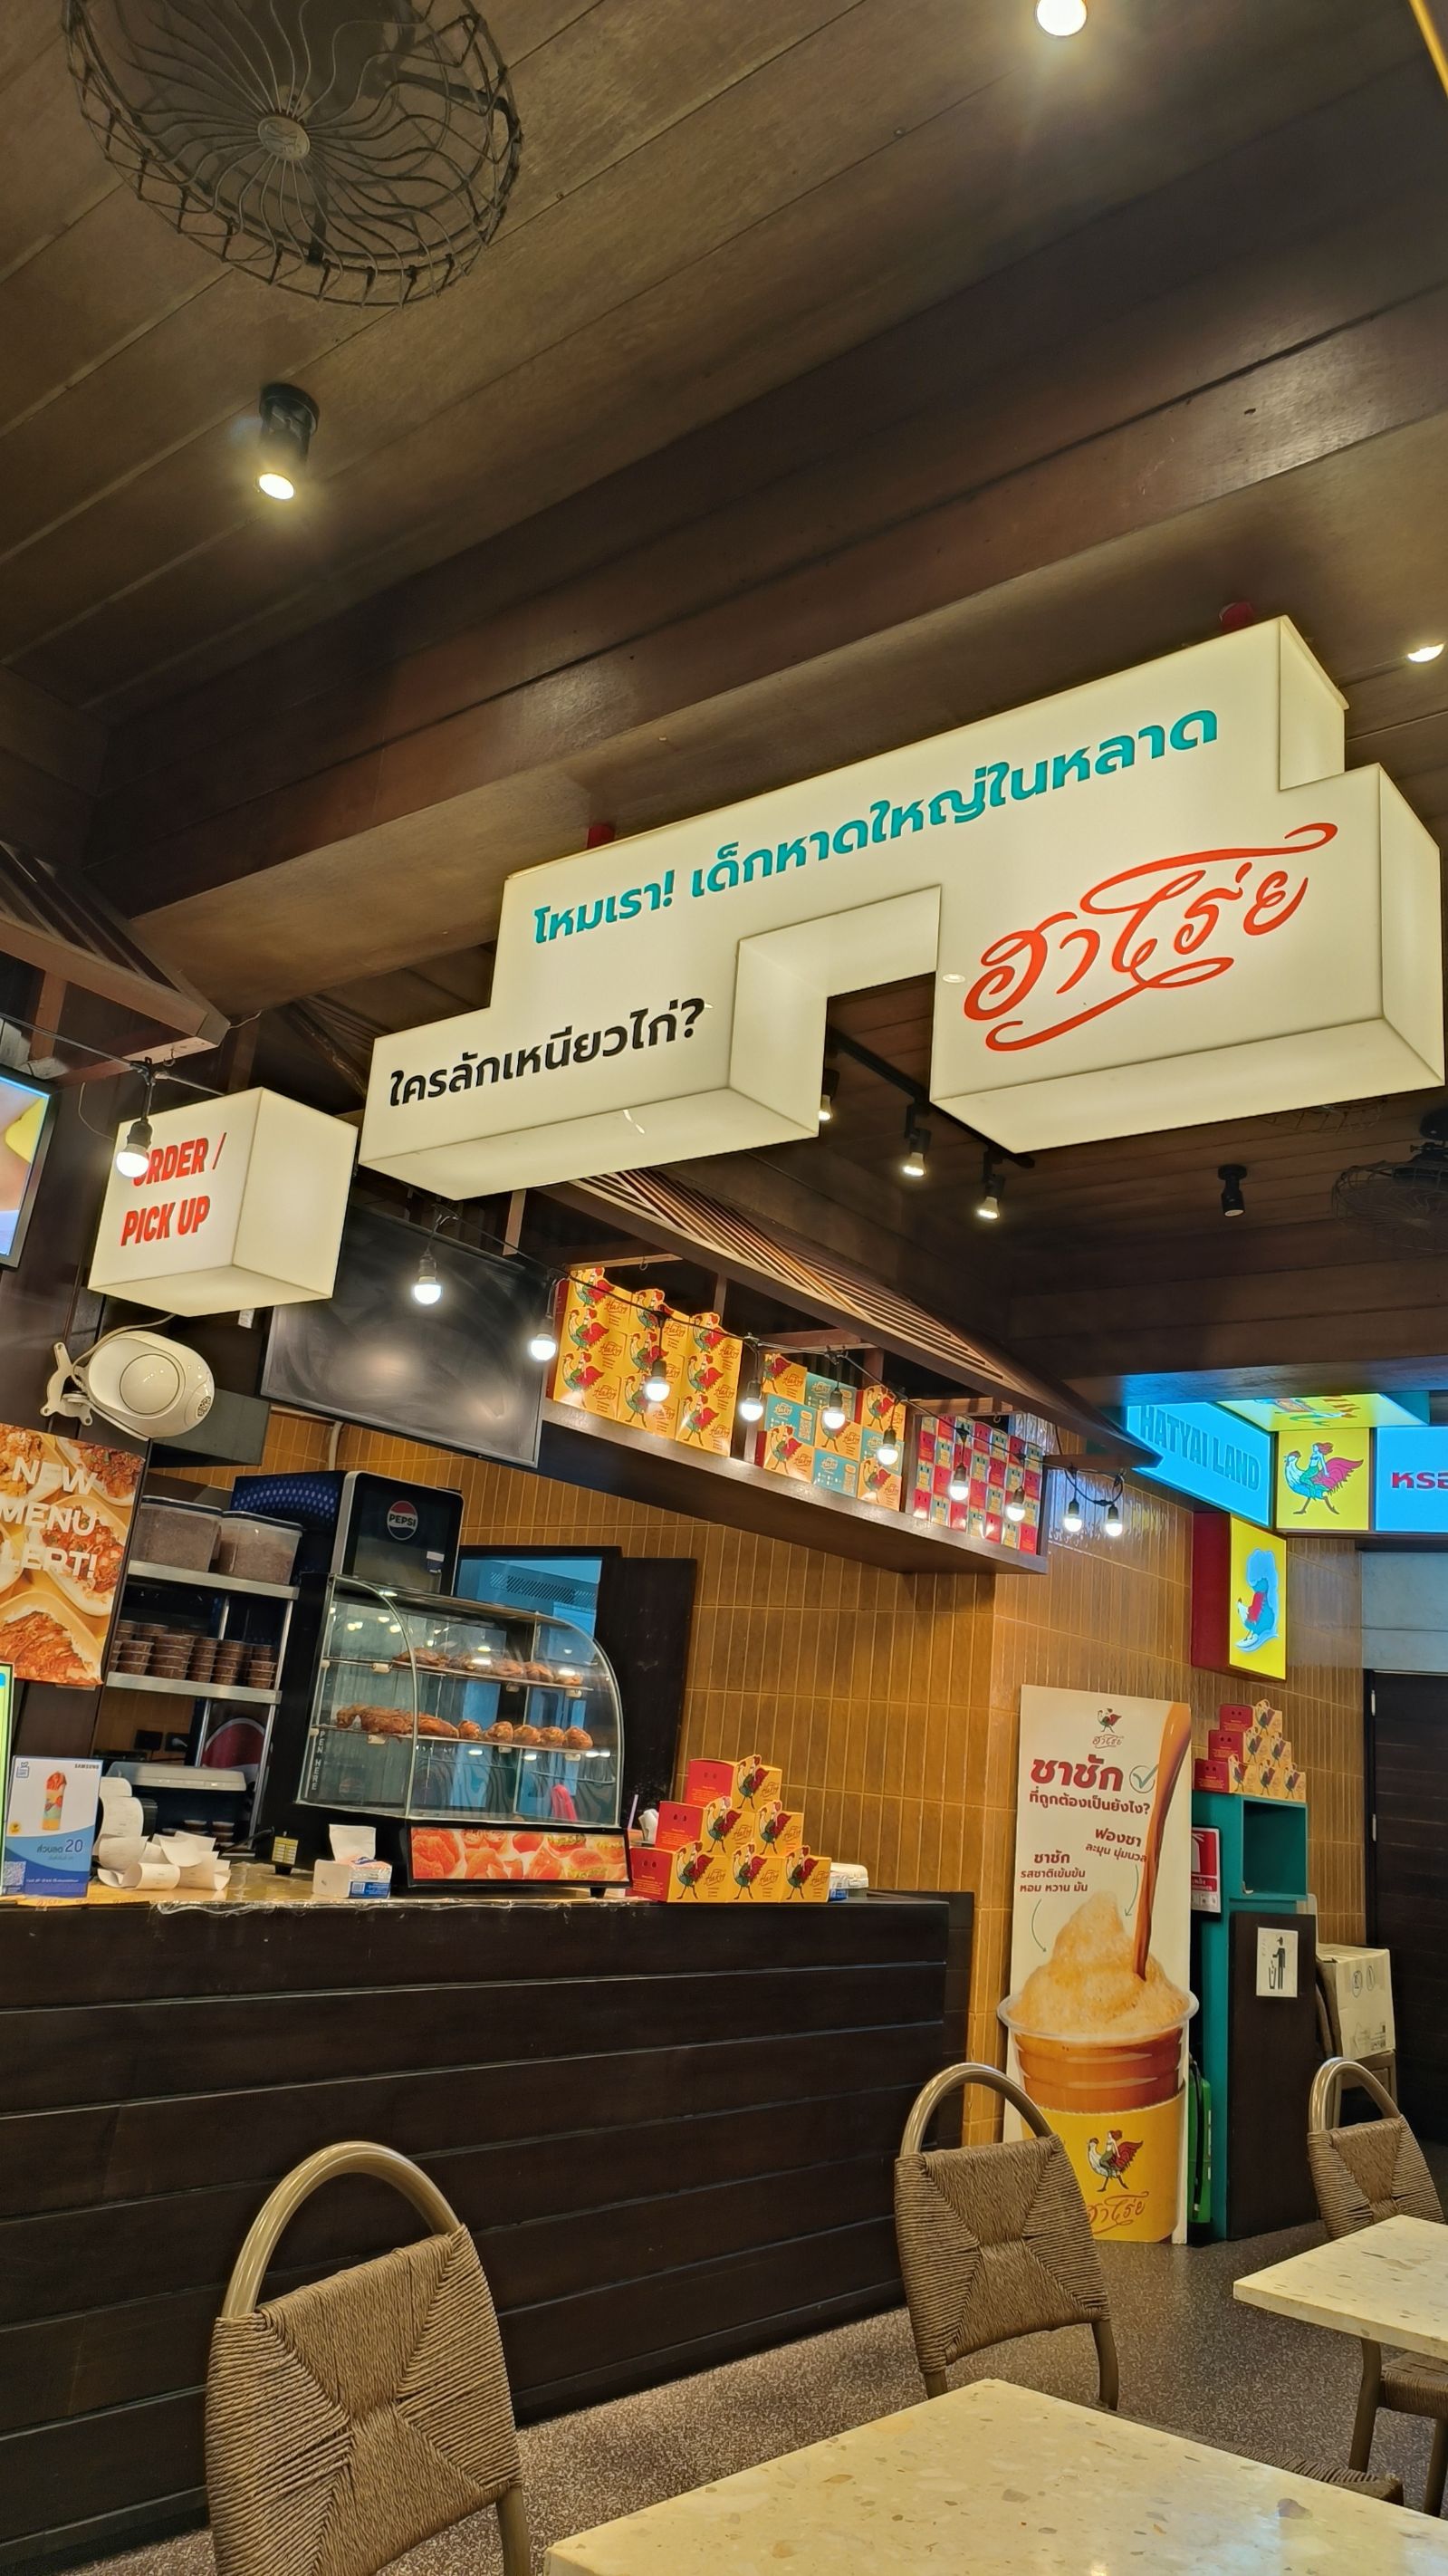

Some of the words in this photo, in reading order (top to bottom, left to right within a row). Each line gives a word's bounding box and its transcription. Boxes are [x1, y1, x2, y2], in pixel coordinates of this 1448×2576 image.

[533, 869, 676, 944] โหมเรา!
[691, 709, 1219, 898] เด็กหาดใหญ่ในหลาด
[389, 997, 705, 1107] ใครลักเหนียวไก่?
[120, 1202, 176, 1246] PICK
[177, 1196, 210, 1235] UP
[1139, 1406, 1210, 1468] HATYAI
[1213, 1437, 1261, 1492] LAND
[12, 1456, 99, 1495] NEW
[0, 1499, 97, 1537] MENU
[388, 1514, 417, 1527] PEPSI
[0, 1539, 98, 1580] LERT!
[317, 1729, 325, 1754] PEN
[312, 1759, 321, 1791] HERE
[1031, 1754, 1124, 1792] ชาชัก
[1029, 1786, 1151, 1815] ที่ถูกต้องเป็นยังไง?
[65, 1839, 83, 1853] 20
[1085, 1842, 1111, 1858] ละมุน
[1095, 1828, 1142, 1848] ฟองชา
[1034, 1850, 1070, 1864] ชาชัก
[1020, 1883, 1041, 1893] หอม
[1045, 1883, 1070, 1892] หวาน
[1073, 1880, 1088, 1892] มัน
[1021, 1868, 1086, 1879] รสชาติเข้มข้น
